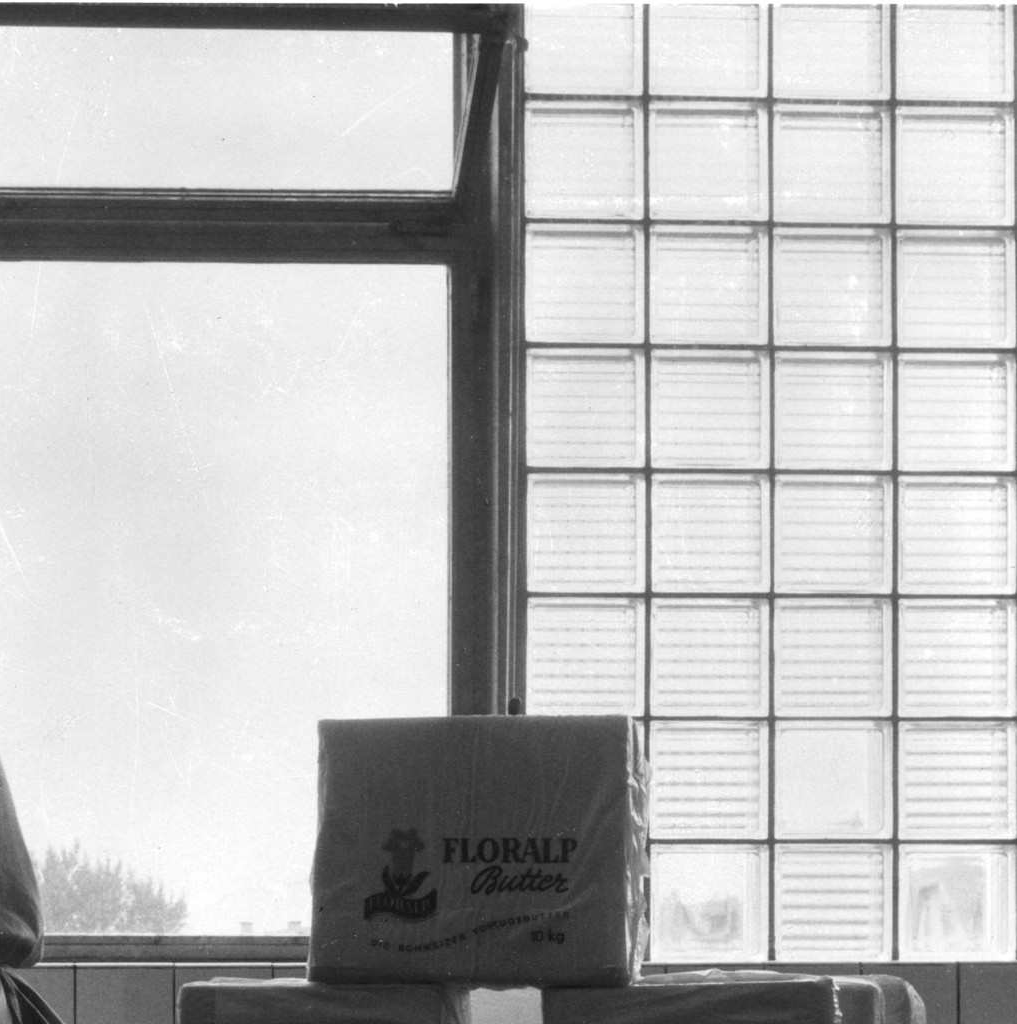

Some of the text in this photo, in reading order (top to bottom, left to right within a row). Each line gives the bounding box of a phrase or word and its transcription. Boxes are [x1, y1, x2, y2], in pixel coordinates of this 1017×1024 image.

[443, 838, 578, 863] FLORALP
[471, 865, 569, 895] Butter
[371, 939, 390, 950] DIE
[398, 933, 466, 952] SCHWEIZER
[531, 928, 565, 944] 10 kg
